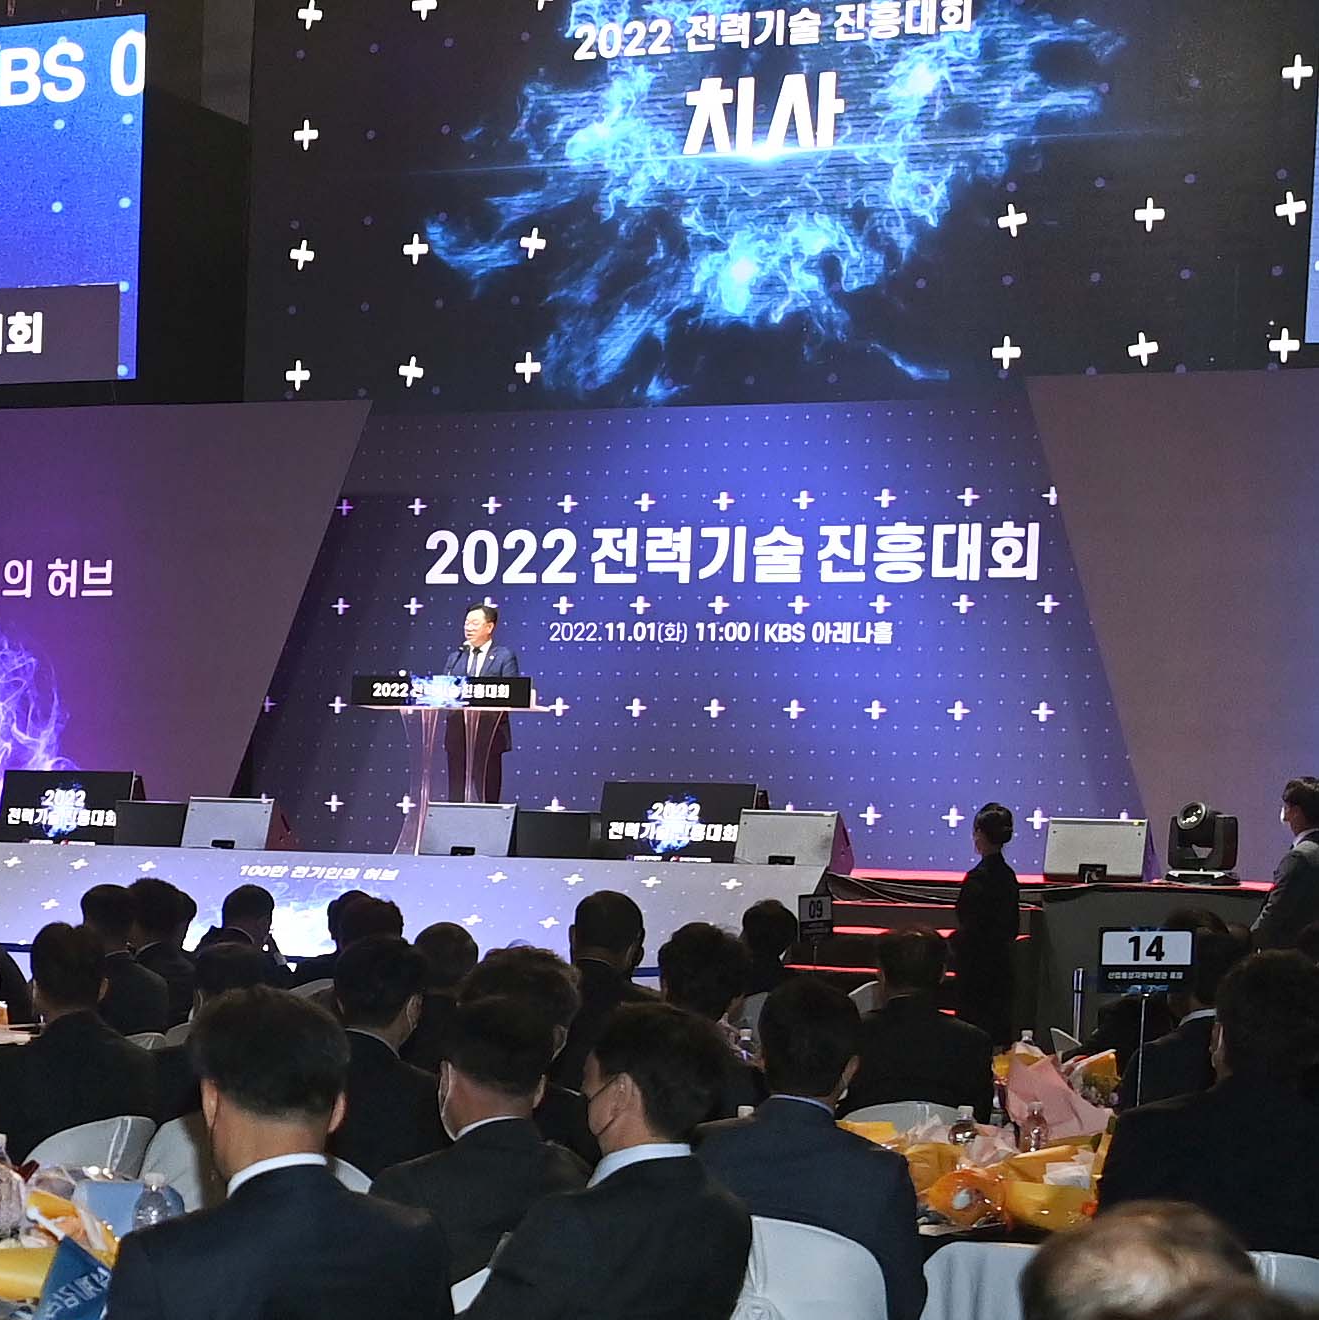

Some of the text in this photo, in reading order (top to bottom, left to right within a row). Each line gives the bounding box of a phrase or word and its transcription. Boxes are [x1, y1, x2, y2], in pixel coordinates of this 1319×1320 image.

[573, 0, 972, 61] 2022 전력기술 진흥대회
[682, 71, 845, 155] 치사
[425, 521, 1040, 585] 2022 전력기술 진흥대회
[47, 558, 113, 599] 허브
[549, 621, 893, 645] 2022.11.01(화) 11:00 KBS 아레나홀
[372, 682, 409, 698] 2022
[240, 865, 400, 881] 100만 전기인의 허브
[808, 900, 823, 919] 09
[1128, 935, 1166, 962] 14
